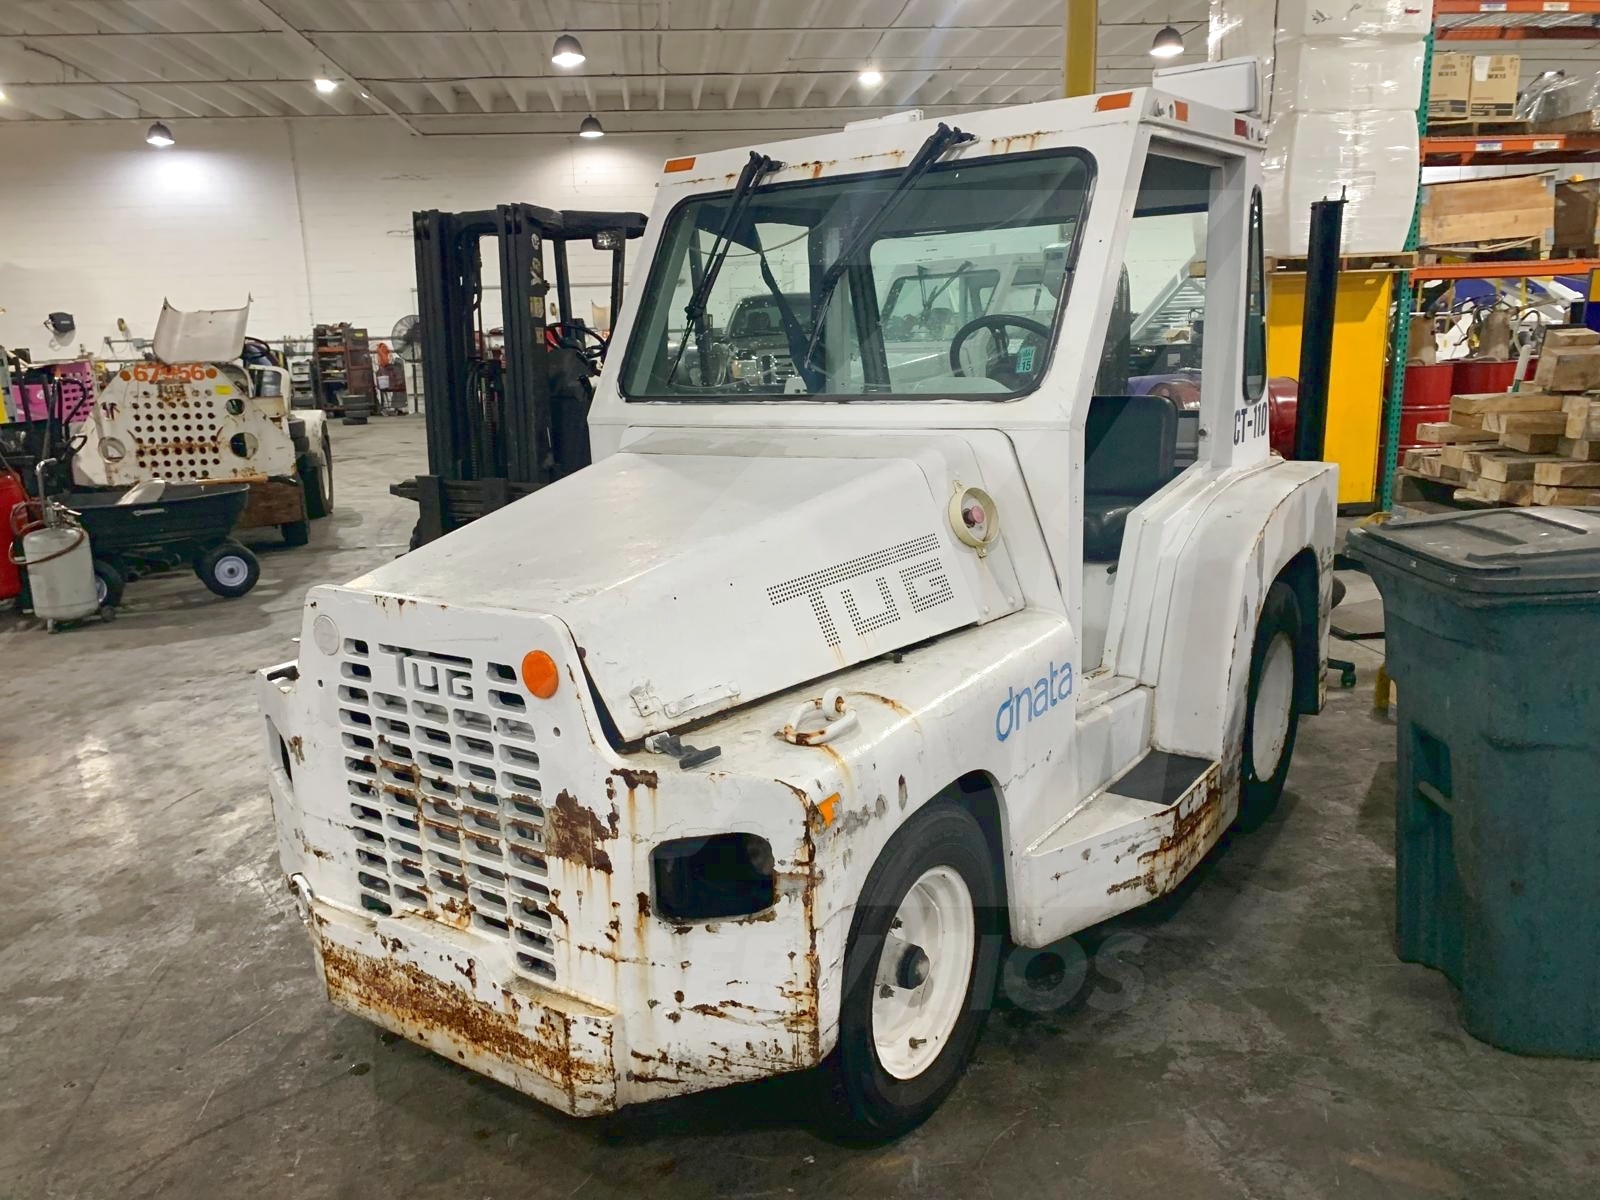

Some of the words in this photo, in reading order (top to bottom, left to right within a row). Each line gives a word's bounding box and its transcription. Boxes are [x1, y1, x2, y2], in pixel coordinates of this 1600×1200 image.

[1233, 402, 1268, 446] CT-110
[766, 532, 954, 647] TUG
[378, 643, 474, 702] TUG
[995, 661, 1073, 742] dnata
